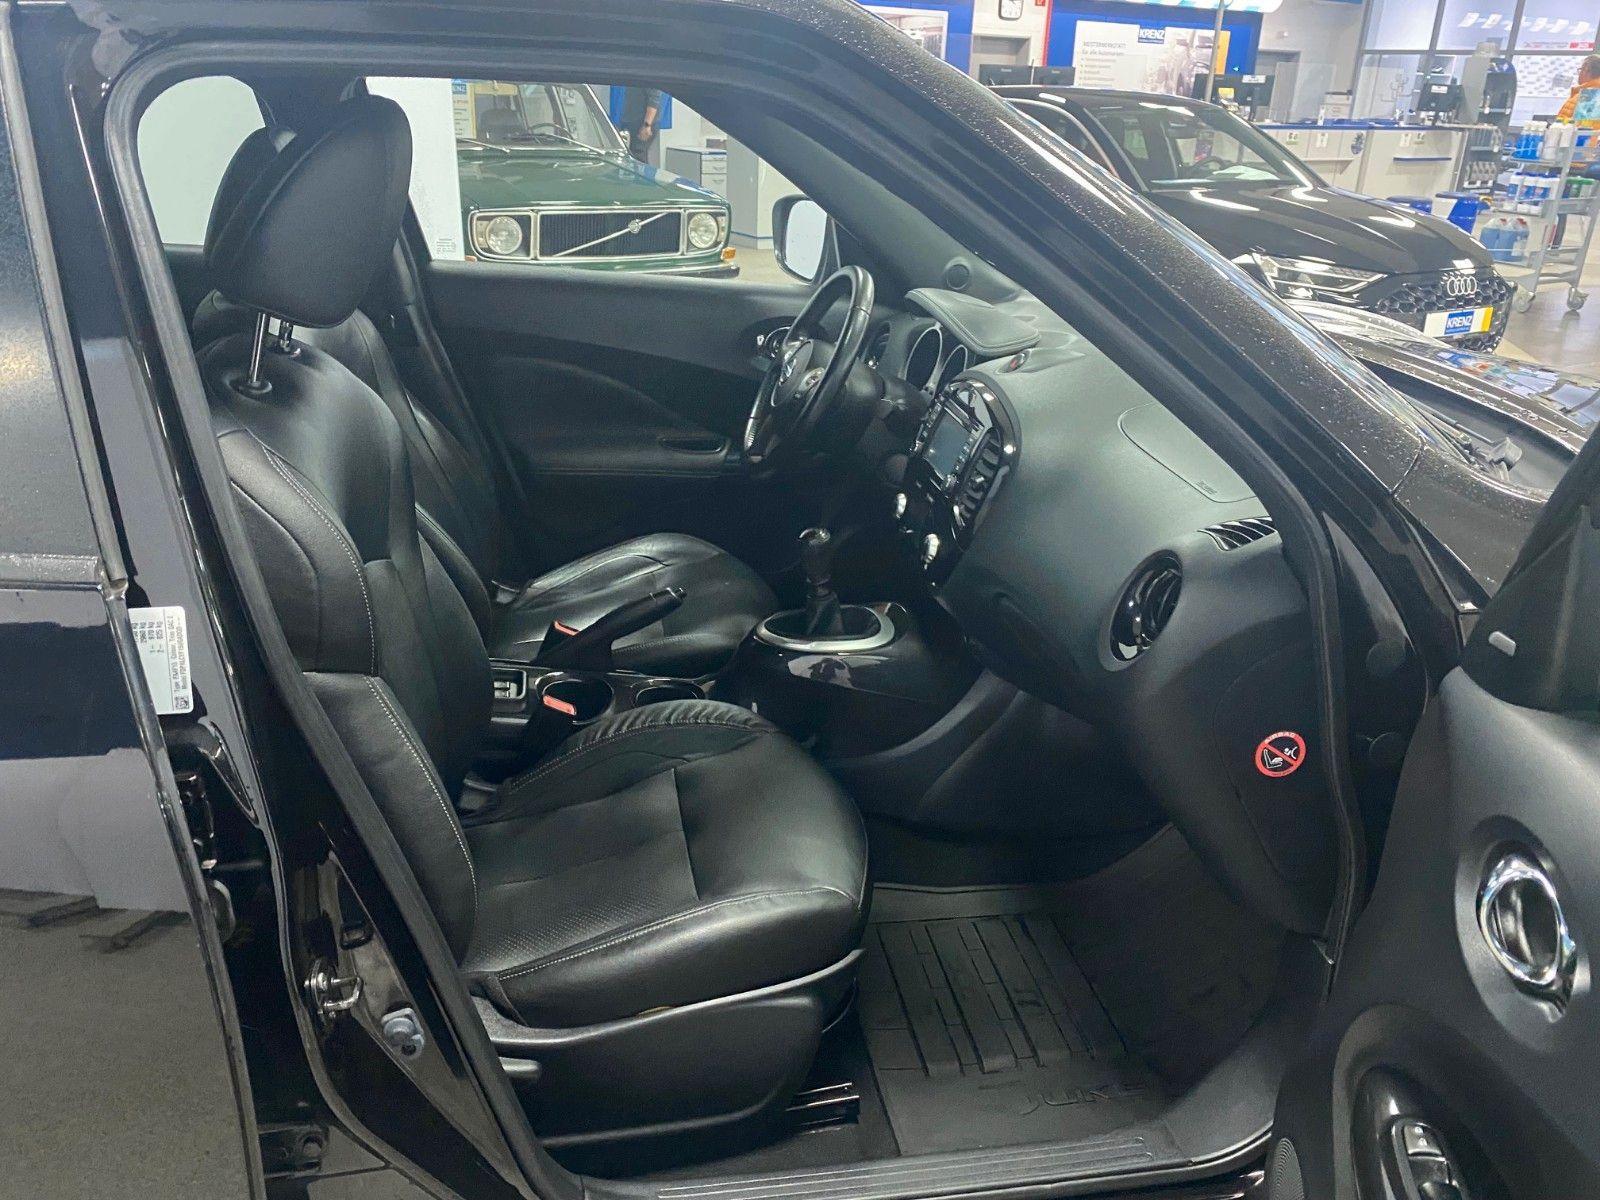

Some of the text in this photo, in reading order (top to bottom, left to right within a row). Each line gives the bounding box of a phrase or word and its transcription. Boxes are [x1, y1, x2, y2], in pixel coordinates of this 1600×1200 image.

[1139, 28, 1166, 39] KRENZ
[1446, 316, 1473, 328] KRENZ
[1264, 731, 1298, 744] AIRBAG
